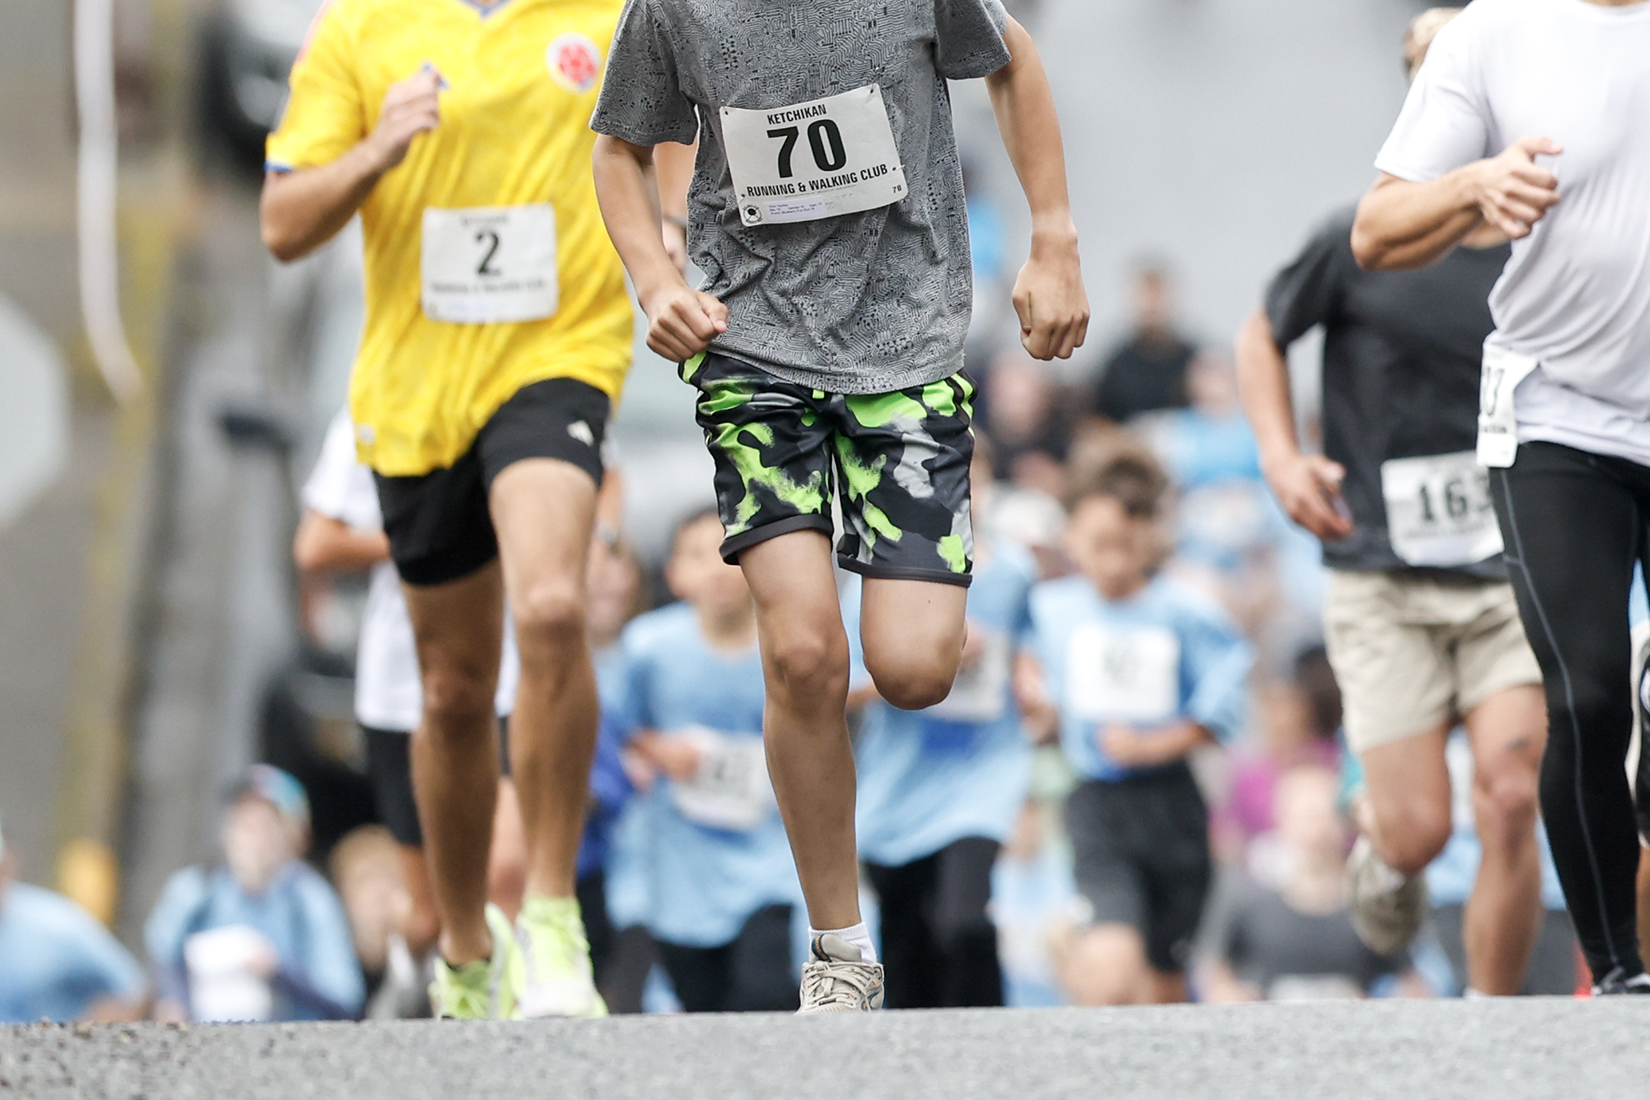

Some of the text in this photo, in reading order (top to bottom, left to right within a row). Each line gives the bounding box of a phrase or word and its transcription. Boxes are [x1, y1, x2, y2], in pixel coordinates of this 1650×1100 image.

[767, 104, 827, 125] KETCHIKAN
[766, 118, 847, 179] 70
[746, 181, 795, 198] RUNNING
[799, 182, 807, 192] &
[808, 172, 858, 191] WALKING
[860, 163, 888, 182] CLUB
[892, 184, 902, 194] 70
[475, 230, 501, 275] 2
